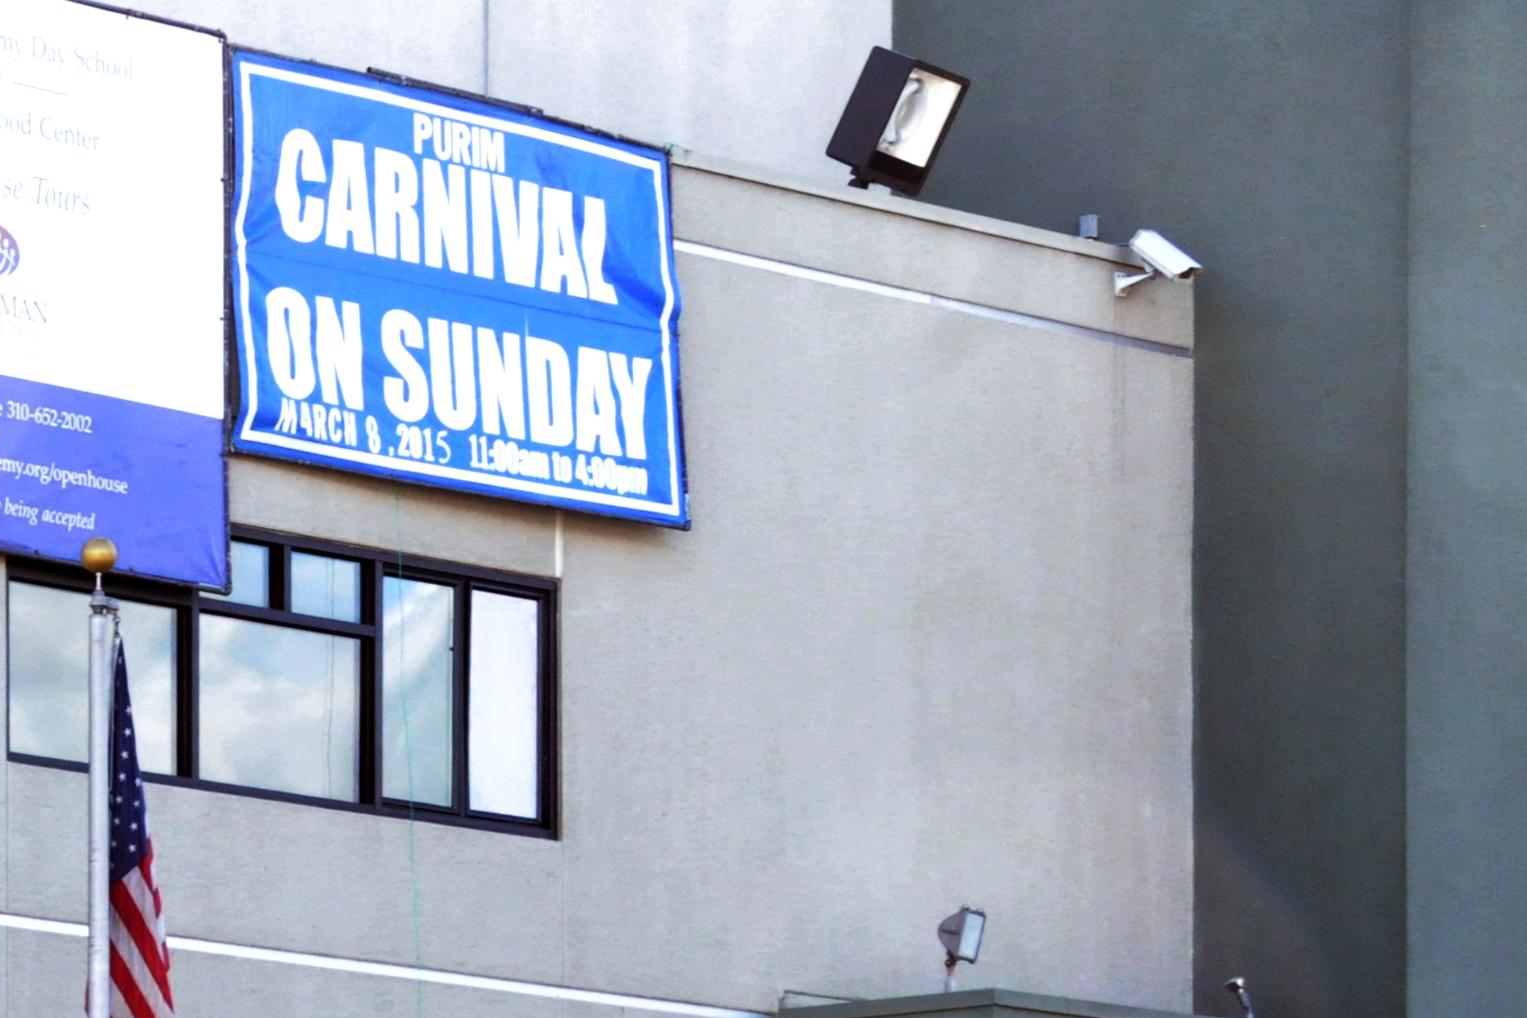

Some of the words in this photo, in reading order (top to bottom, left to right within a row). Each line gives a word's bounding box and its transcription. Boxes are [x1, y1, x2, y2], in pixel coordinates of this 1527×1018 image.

[32, 35, 65, 71] Day
[73, 46, 133, 80] School
[40, 117, 100, 150] Center
[413, 113, 505, 173] PURIM
[33, 176, 90, 215] Tours
[275, 128, 618, 306] CARNIVAL
[265, 286, 365, 411] ON
[381, 309, 652, 460] SUNDAY
[6, 400, 92, 434] 310-652-2002
[274, 398, 357, 446] MARCH
[469, 434, 550, 480] 11:00am
[553, 449, 572, 483] to
[575, 453, 648, 496] 4:00pm
[4, 498, 38, 524] being
[41, 507, 96, 531] accepted
